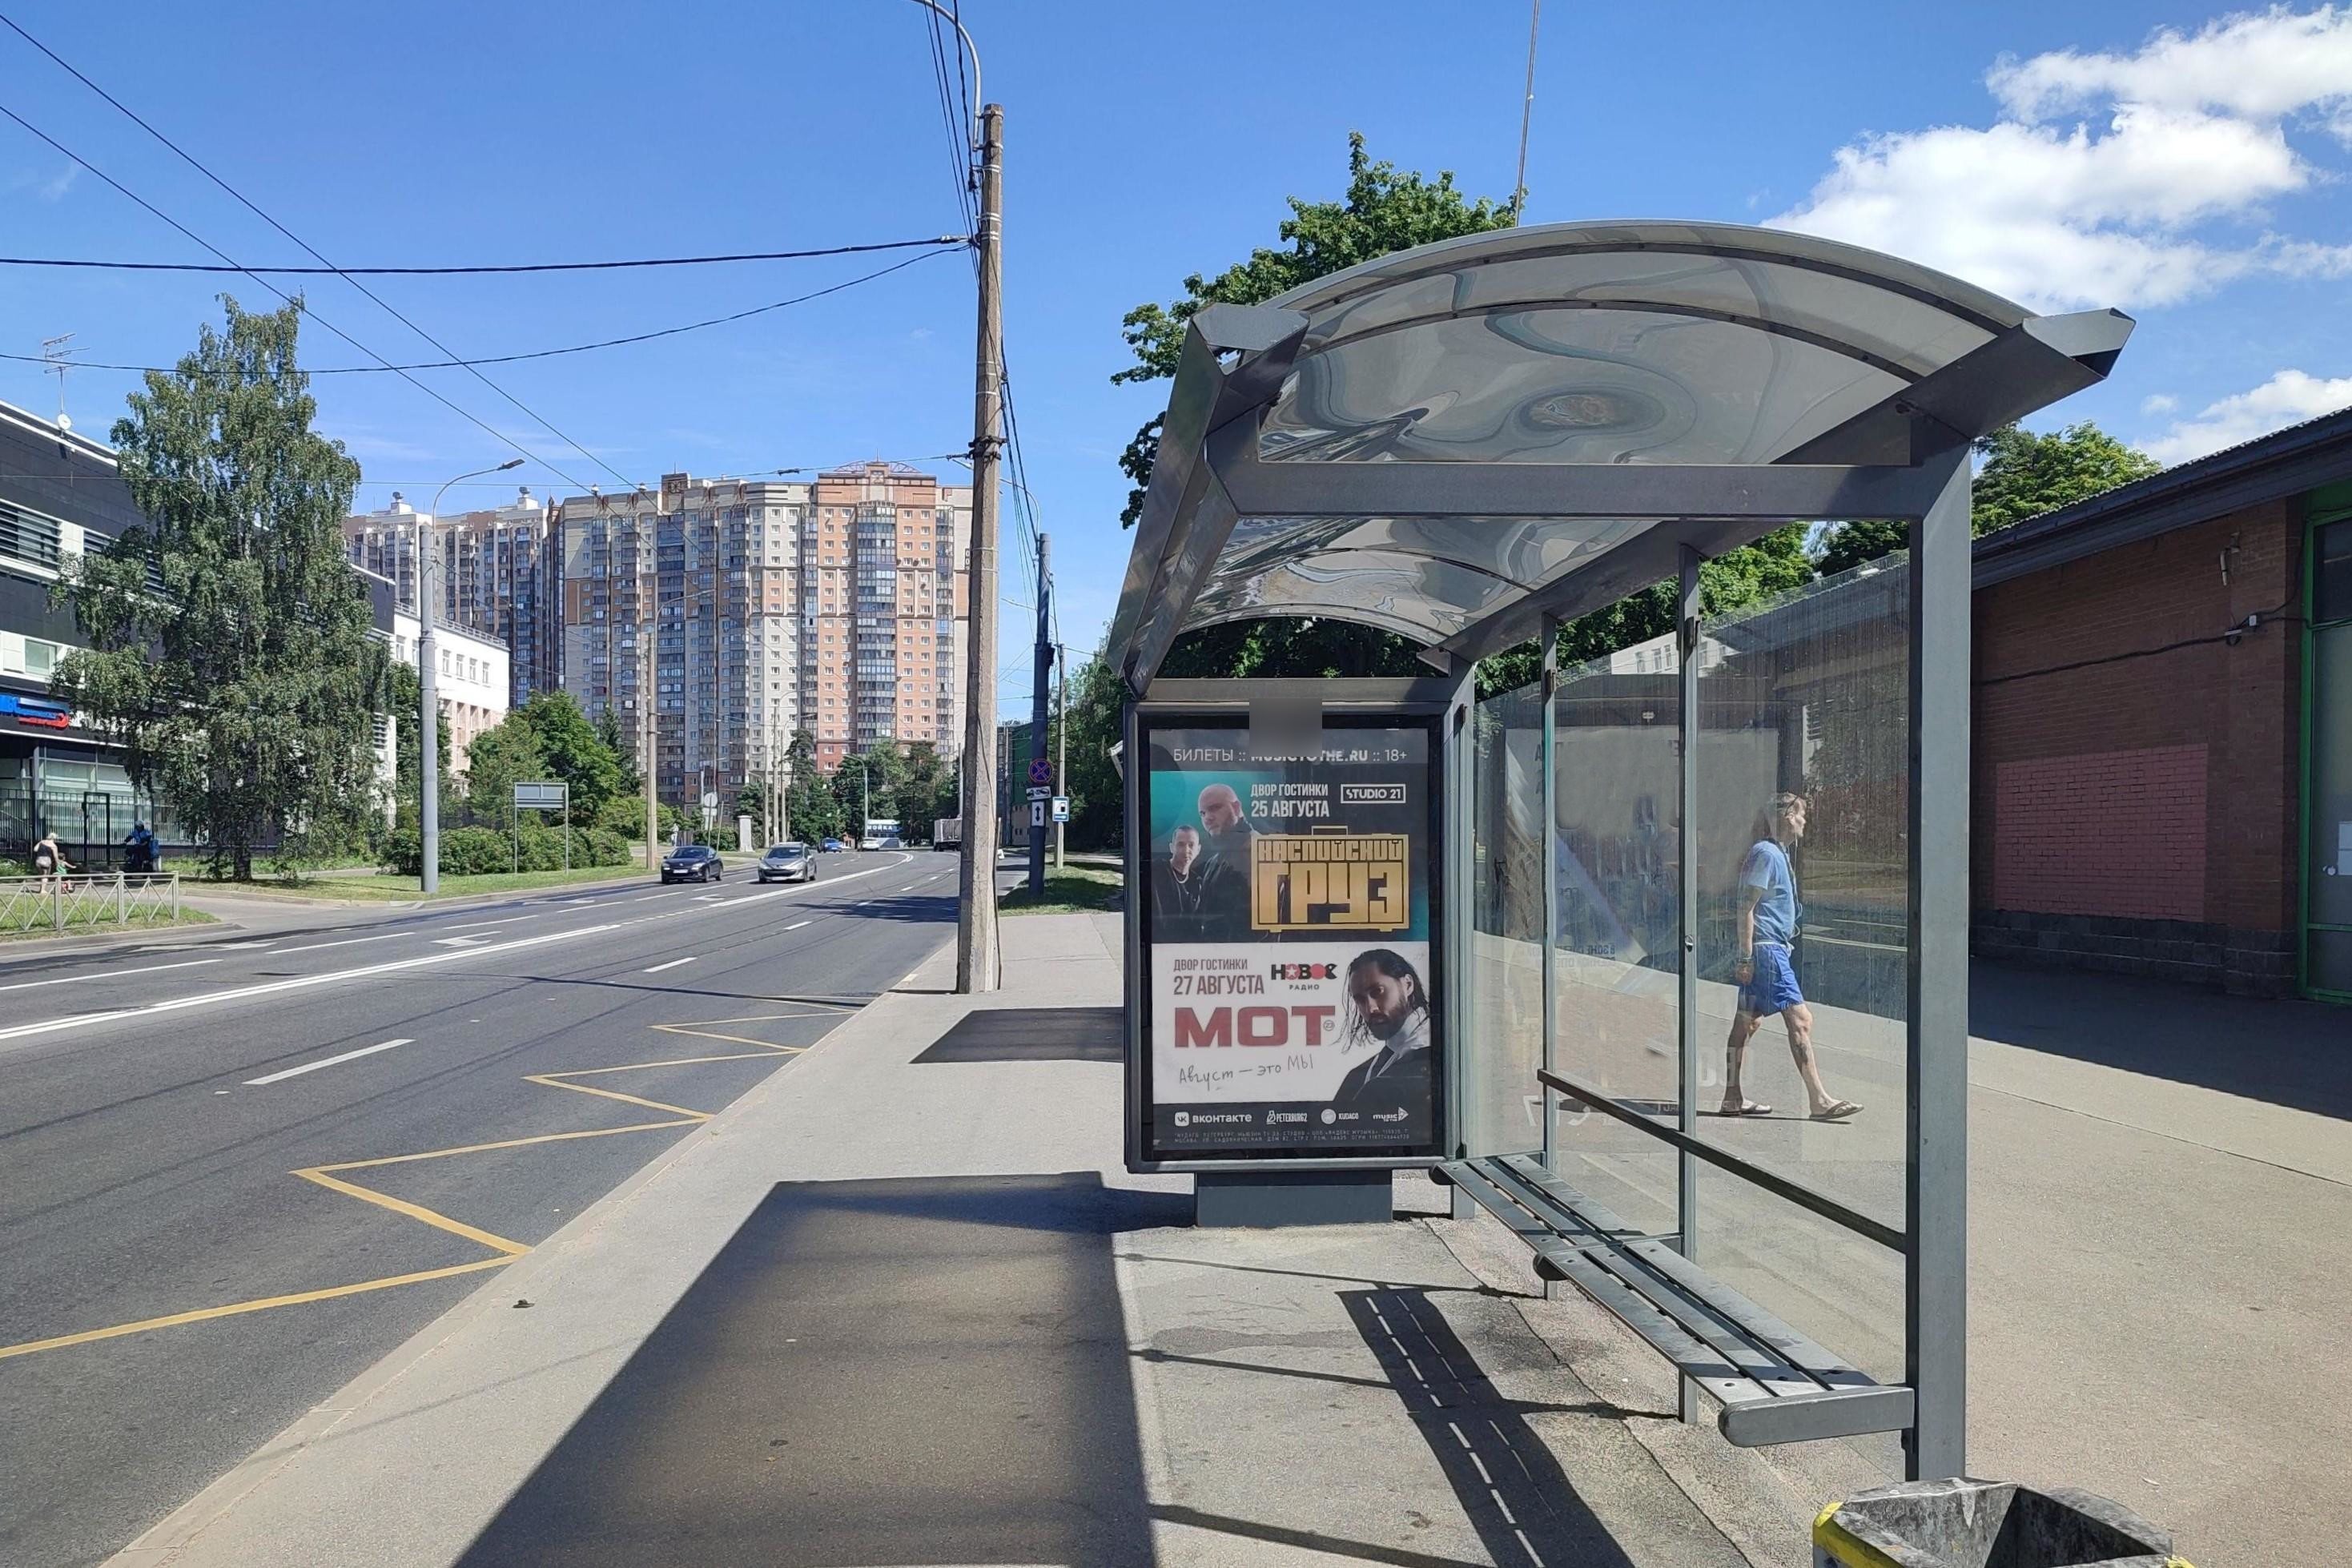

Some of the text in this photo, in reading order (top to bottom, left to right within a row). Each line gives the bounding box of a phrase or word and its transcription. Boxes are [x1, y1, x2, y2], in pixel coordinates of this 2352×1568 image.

[1173, 749, 1233, 762] БИЛЕТЫ
[1385, 749, 1408, 762] 18+
[1250, 783, 1329, 797] ДВОР ГОСТИНКИ
[1345, 789, 1401, 799] STUDIO 21
[1251, 799, 1330, 818] 25 АВГУСТА
[1258, 839, 1403, 862] КАСПИЙСКИЙ
[1258, 862, 1403, 923] ГРУЗ
[1173, 959, 1248, 972] ДВОР ГОСТИНКИ
[1173, 974, 1265, 995] 27 АВГУСТА
[1174, 1005, 1336, 1048] МОТ
[1179, 1064, 1234, 1092] Август
[1256, 1064, 1281, 1076] это
[1287, 1053, 1314, 1071] МЫ
